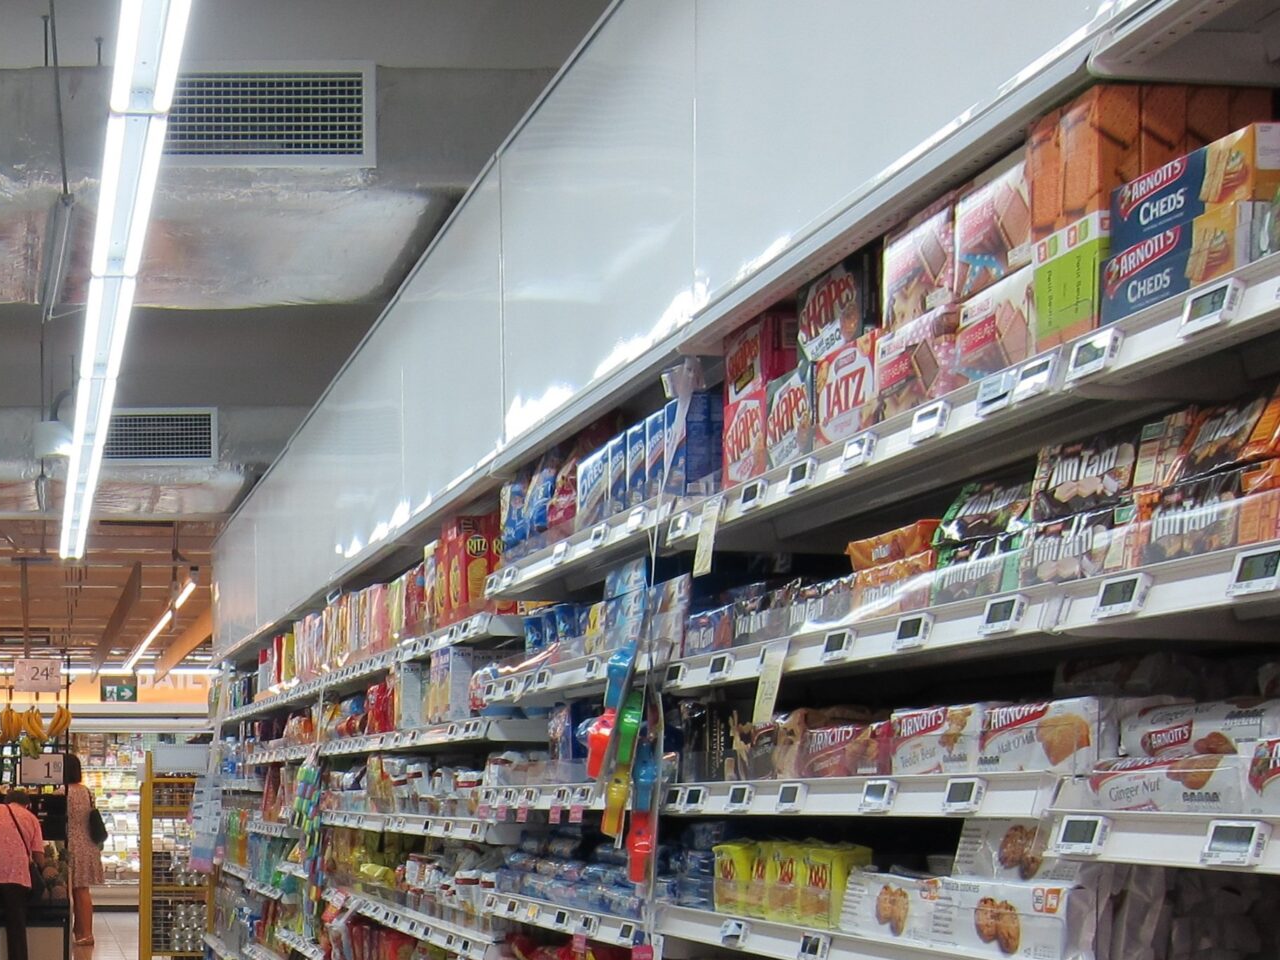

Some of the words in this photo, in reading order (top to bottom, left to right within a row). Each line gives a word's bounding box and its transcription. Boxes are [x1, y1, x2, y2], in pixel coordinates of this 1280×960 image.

[1139, 189, 1187, 226] CHEDS
[1127, 269, 1171, 304] CHEDS
[823, 366, 867, 424] JATZ
[1109, 781, 1142, 804] Ginger
